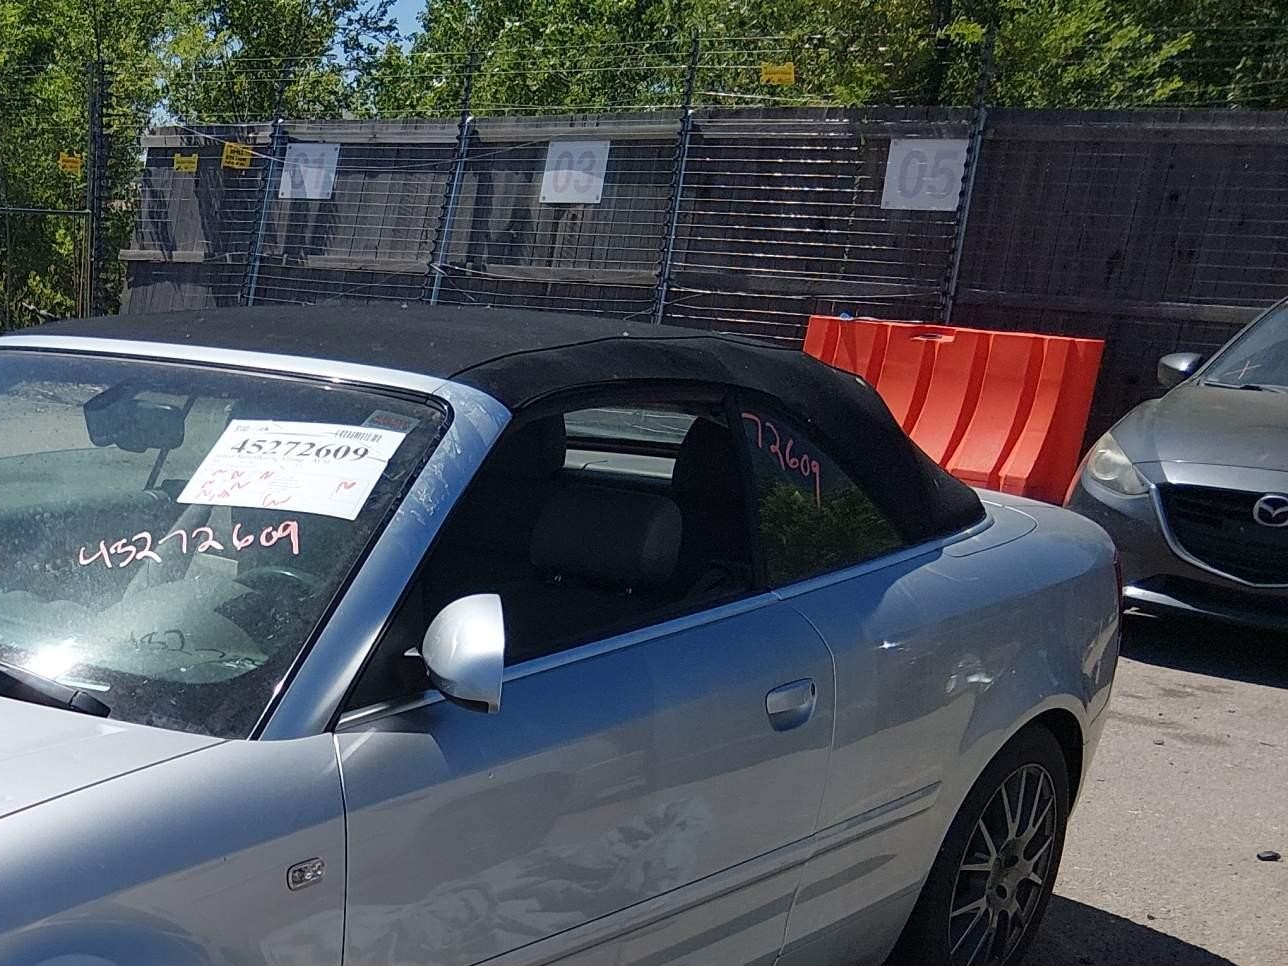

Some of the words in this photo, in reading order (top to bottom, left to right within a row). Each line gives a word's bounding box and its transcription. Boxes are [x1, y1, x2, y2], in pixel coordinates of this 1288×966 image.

[552, 150, 597, 193] 03
[898, 150, 959, 199] 05
[229, 438, 370, 462] 45272609
[740, 411, 821, 509] 72609
[78, 520, 300, 569] 45272609
